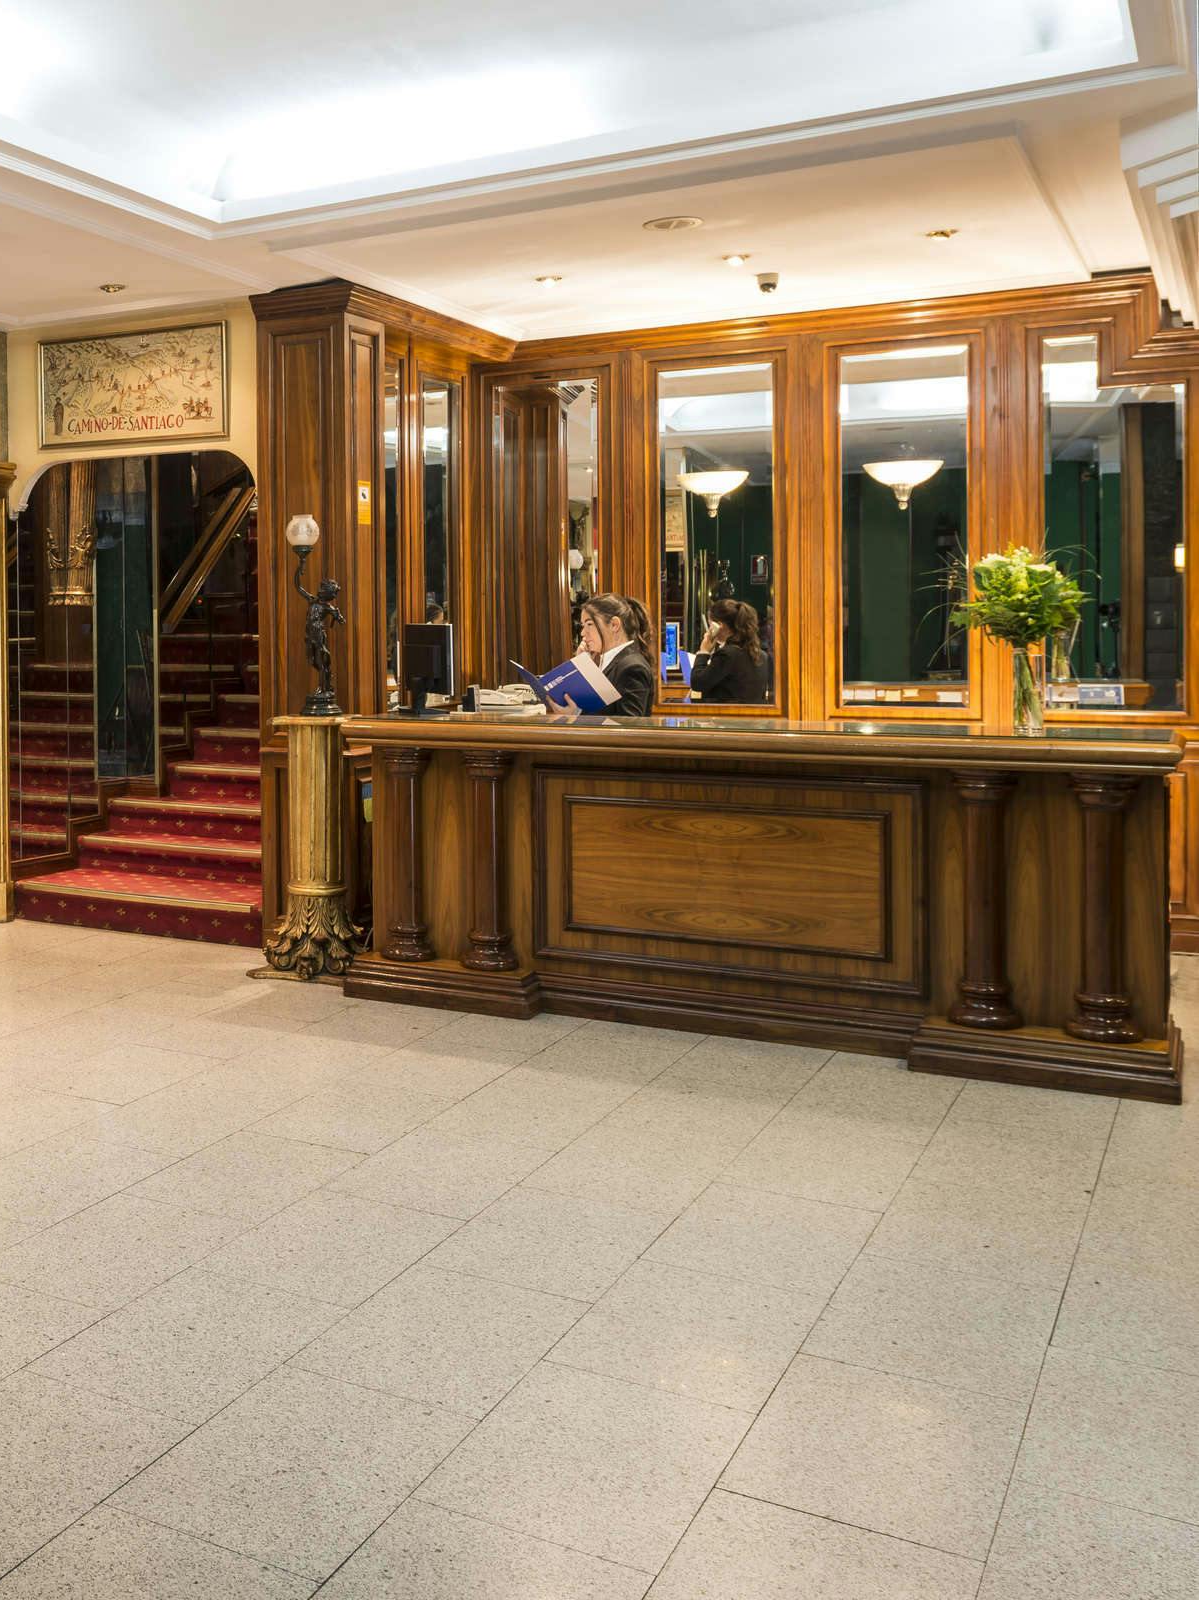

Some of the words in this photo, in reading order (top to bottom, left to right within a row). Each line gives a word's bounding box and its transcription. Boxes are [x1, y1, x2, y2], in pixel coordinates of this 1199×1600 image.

[67, 417, 108, 435] CAMINO
[111, 416, 126, 430] DE
[126, 414, 185, 431] SANTIAGO
